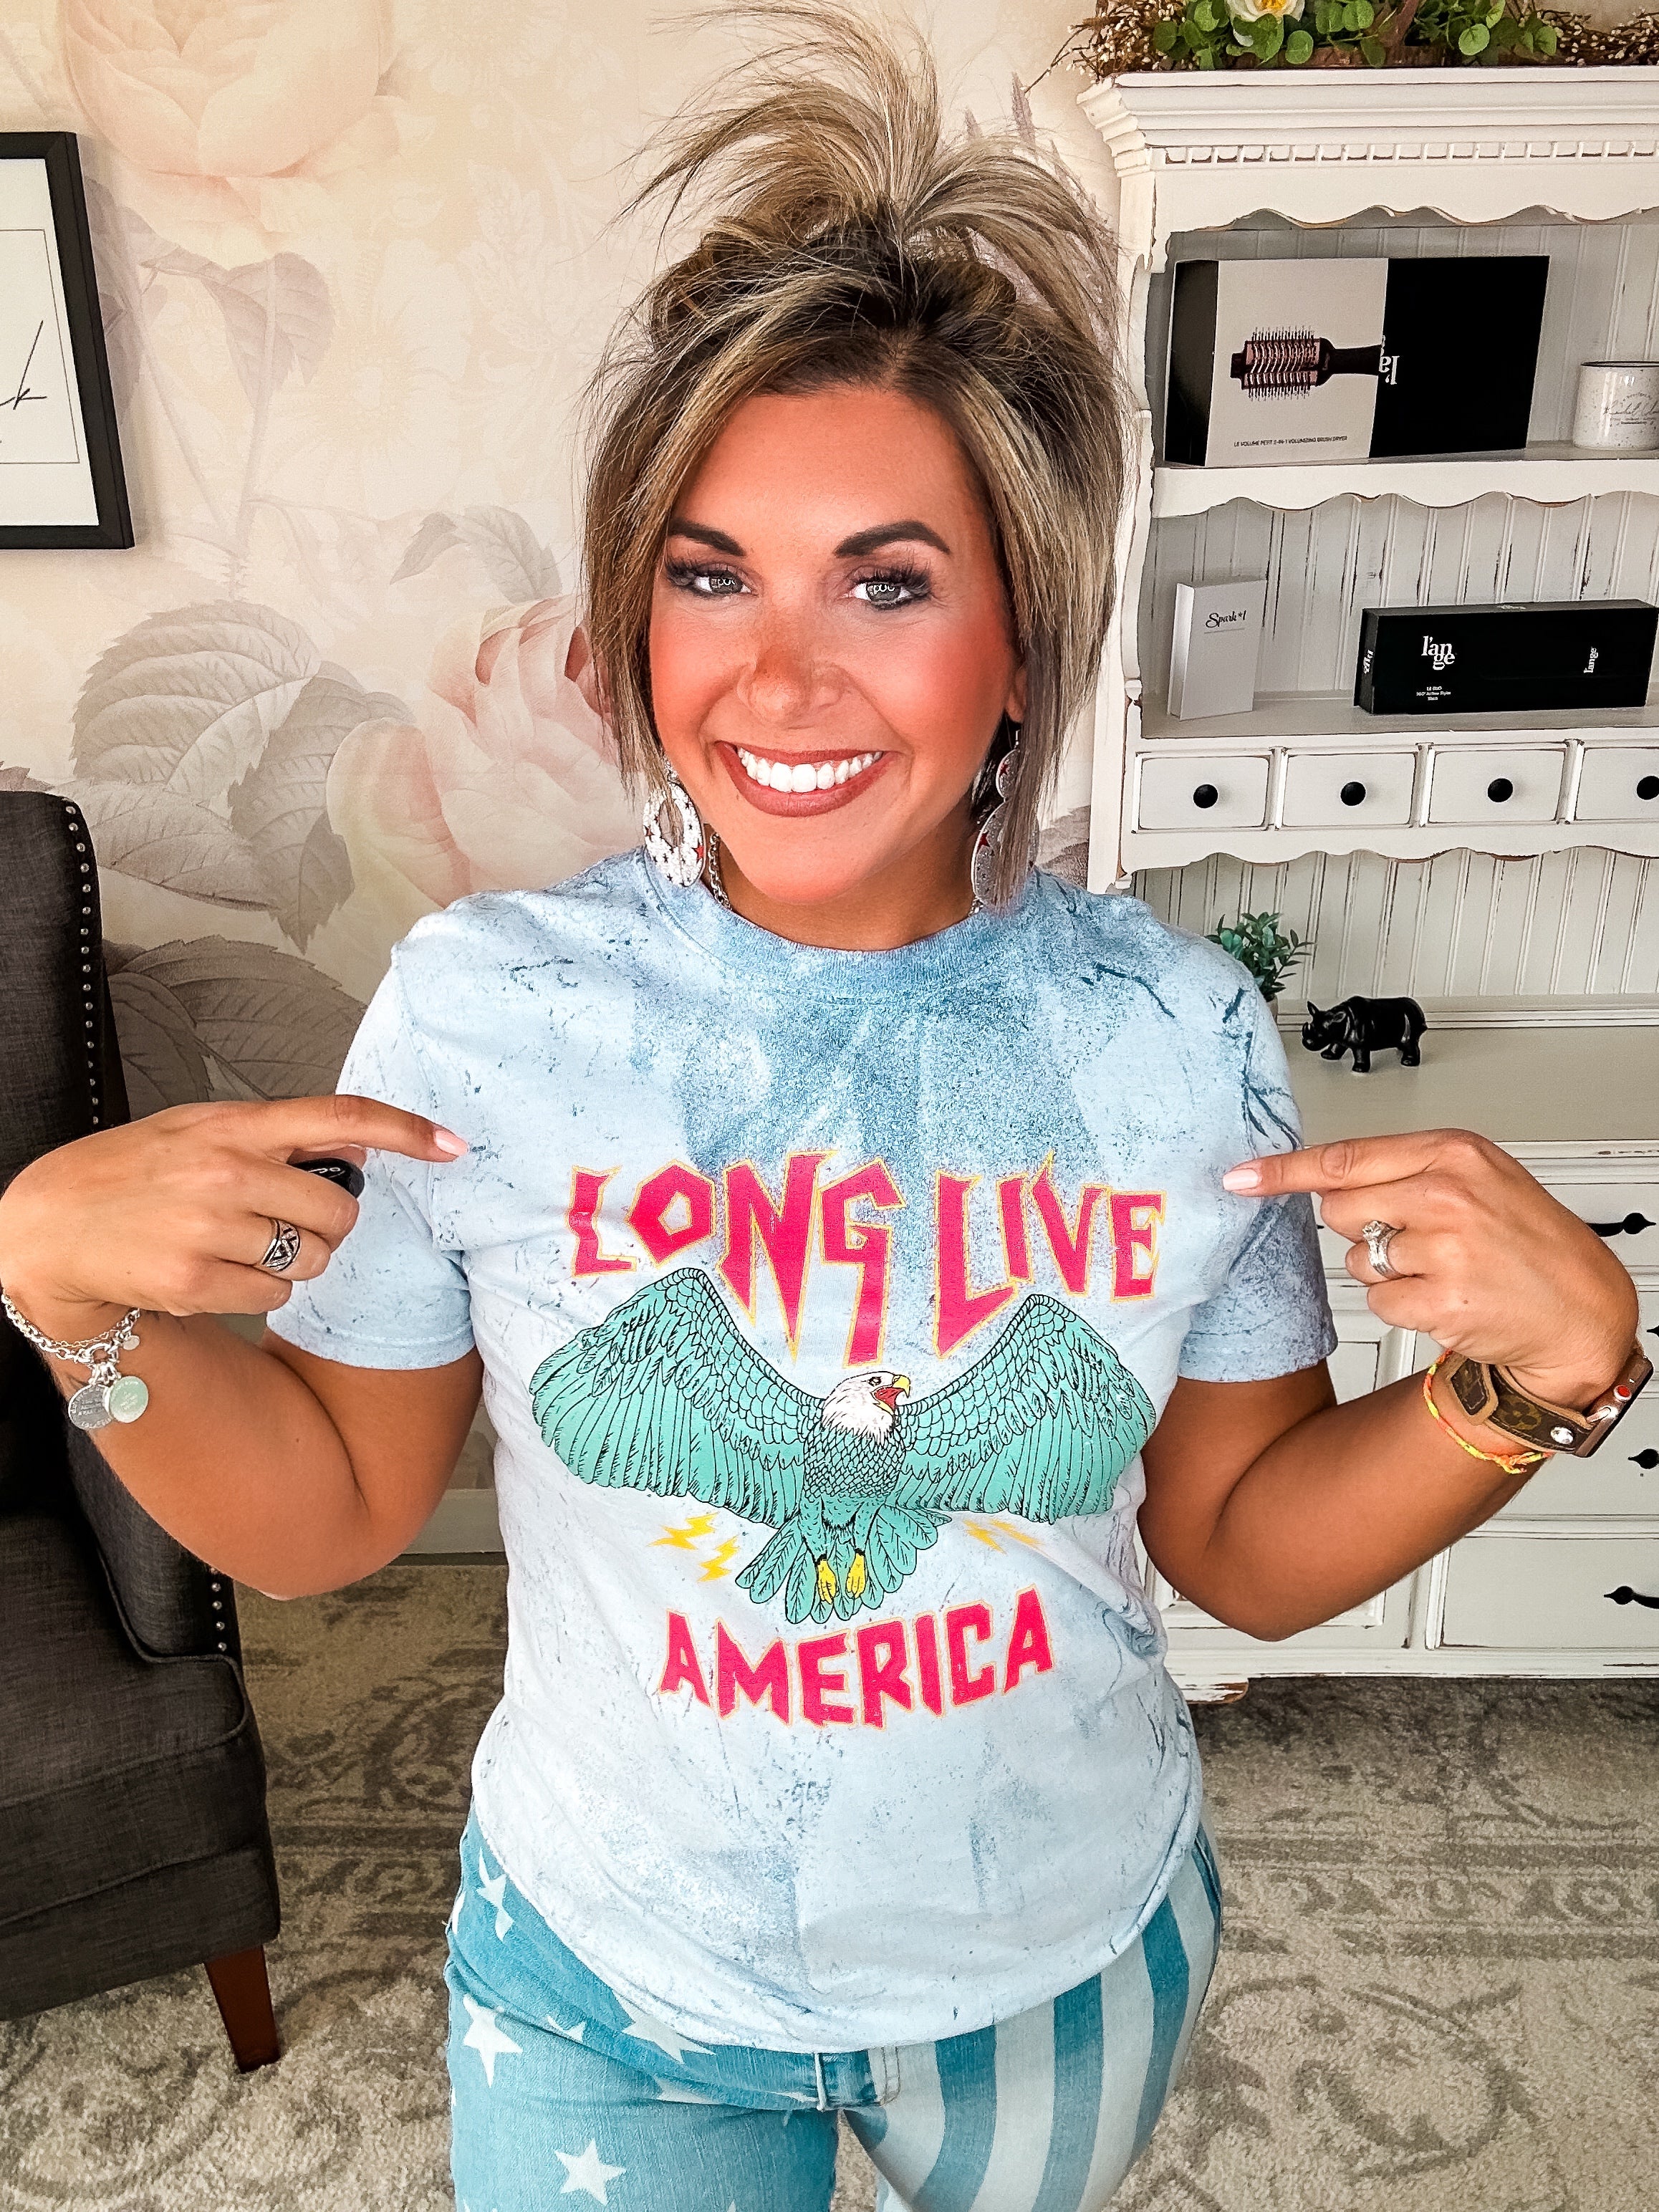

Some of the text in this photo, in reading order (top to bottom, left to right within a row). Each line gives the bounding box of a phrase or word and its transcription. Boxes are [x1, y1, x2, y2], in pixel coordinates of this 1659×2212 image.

[570, 1148, 1168, 1368] LONG LIVE
[658, 1583, 1056, 1729] AMERICA
